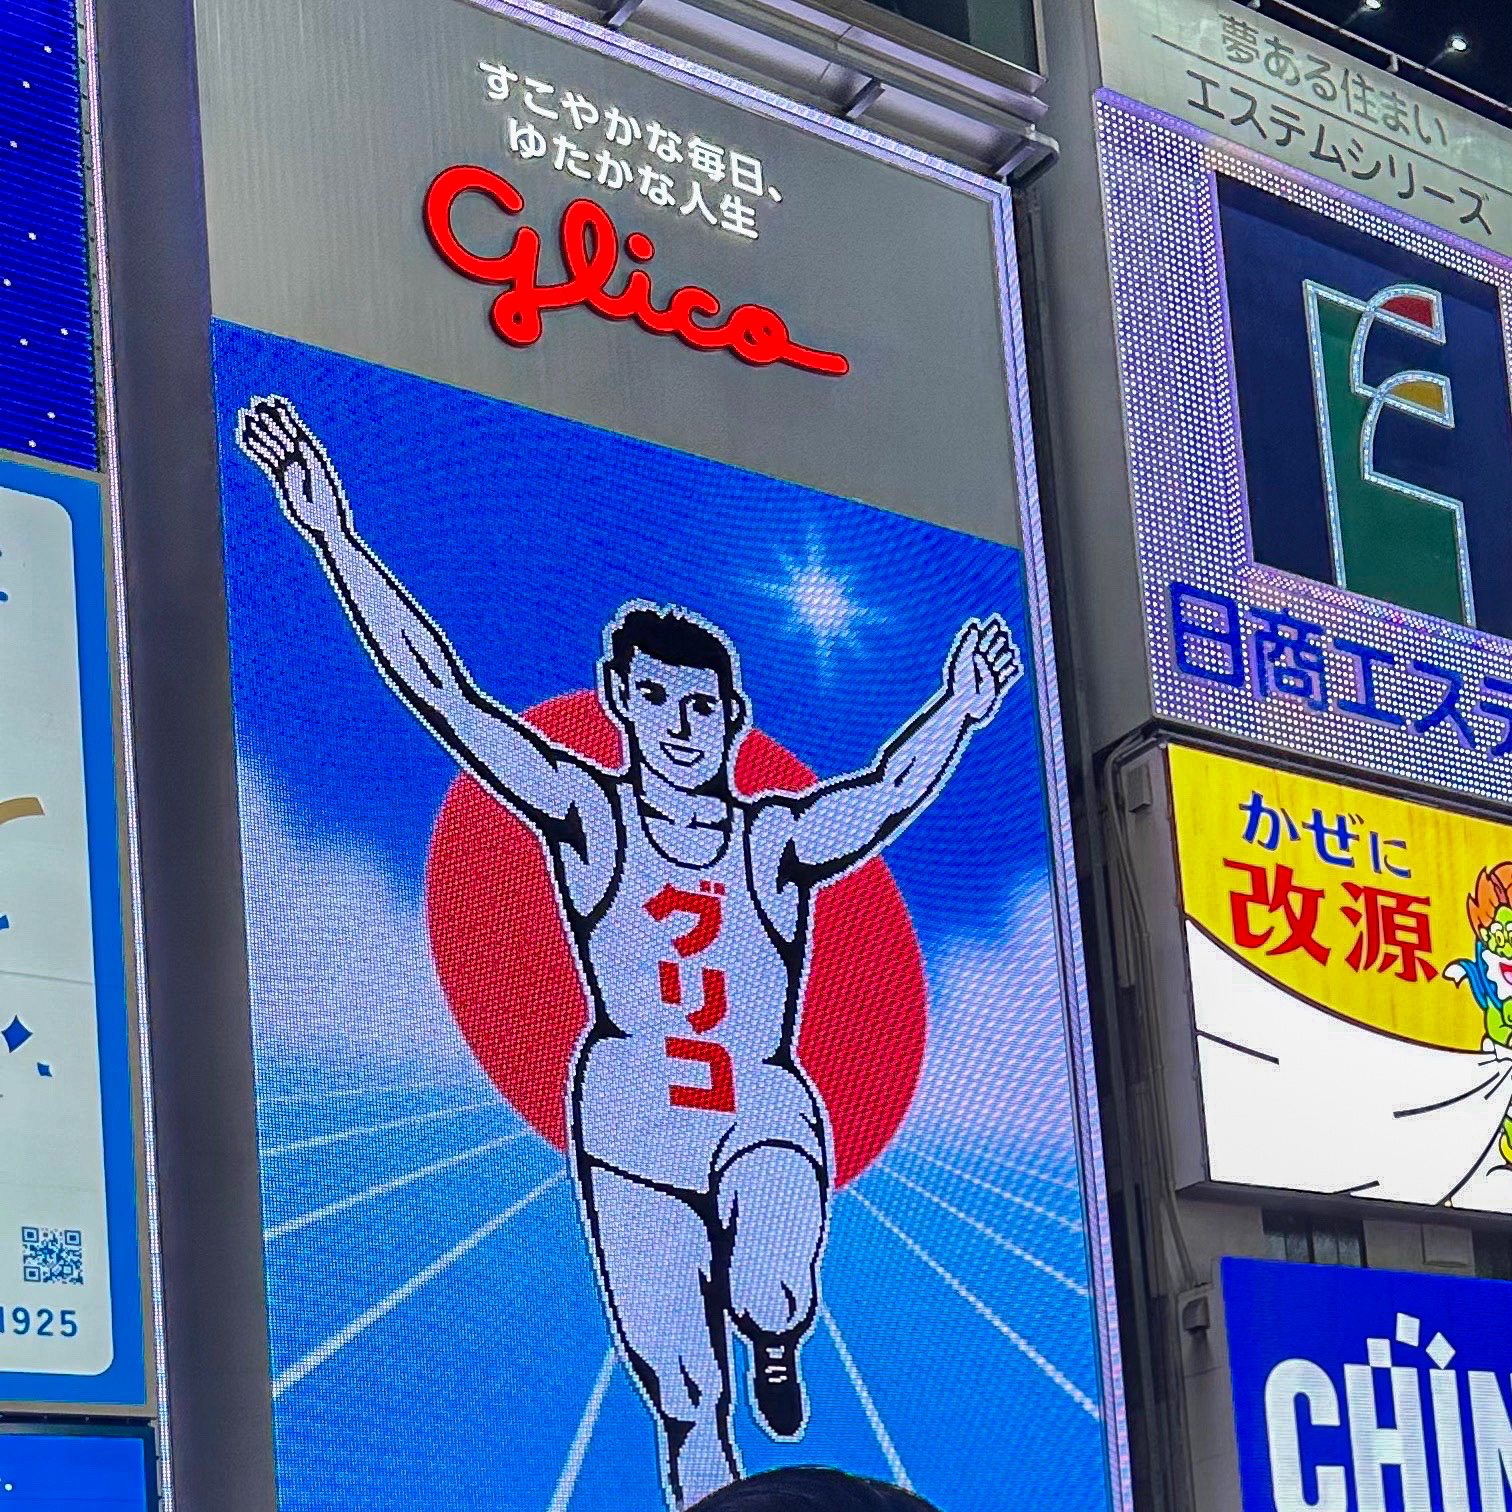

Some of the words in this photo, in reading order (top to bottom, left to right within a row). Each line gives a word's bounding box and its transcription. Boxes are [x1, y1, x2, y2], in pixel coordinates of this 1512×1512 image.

[478, 60, 782, 203] すこやかな毎日、
[1219, 14, 1447, 147] 夢ある住まい
[507, 116, 760, 241] ゆたかな人生
[1186, 70, 1493, 235] エステムシリーズ
[424, 165, 850, 376] Glico
[1239, 790, 1412, 879] かぜに
[1222, 858, 1439, 983] 改源
[643, 880, 737, 1114] グリコ
